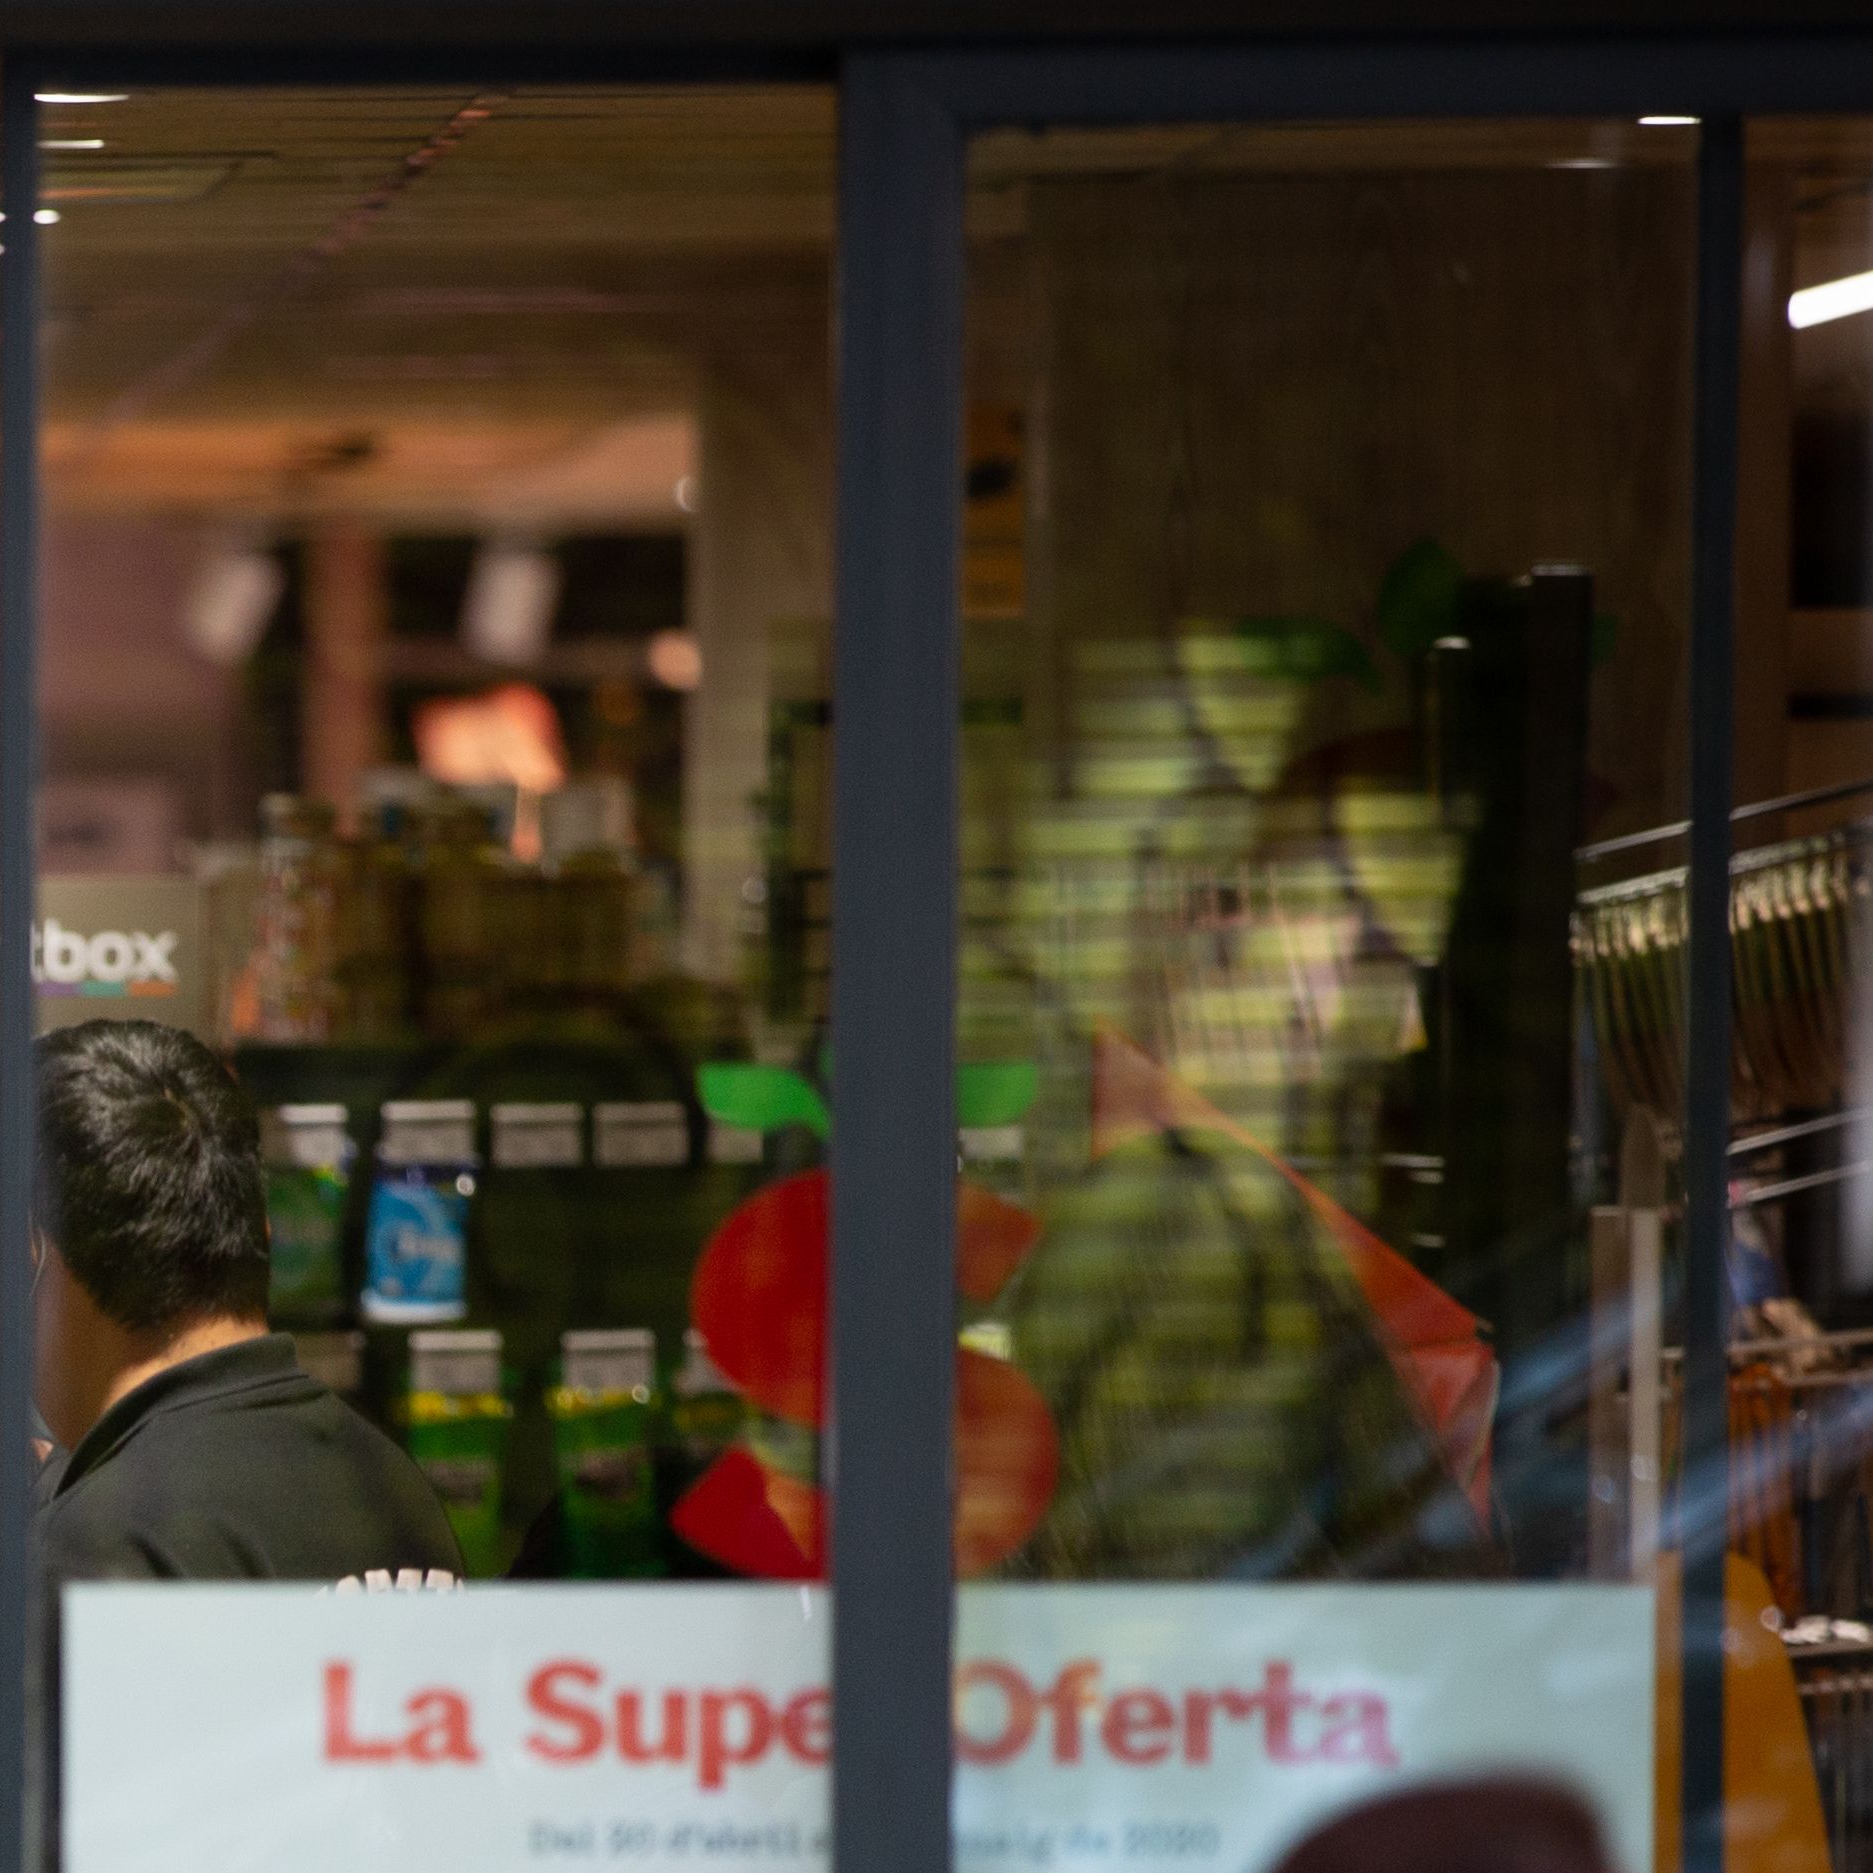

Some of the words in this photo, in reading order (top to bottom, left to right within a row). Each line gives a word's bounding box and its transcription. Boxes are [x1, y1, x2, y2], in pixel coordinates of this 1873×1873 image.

[322, 1659, 482, 1767] La
[523, 1659, 834, 1793] Supe
[954, 1657, 1402, 1768] Oferta
